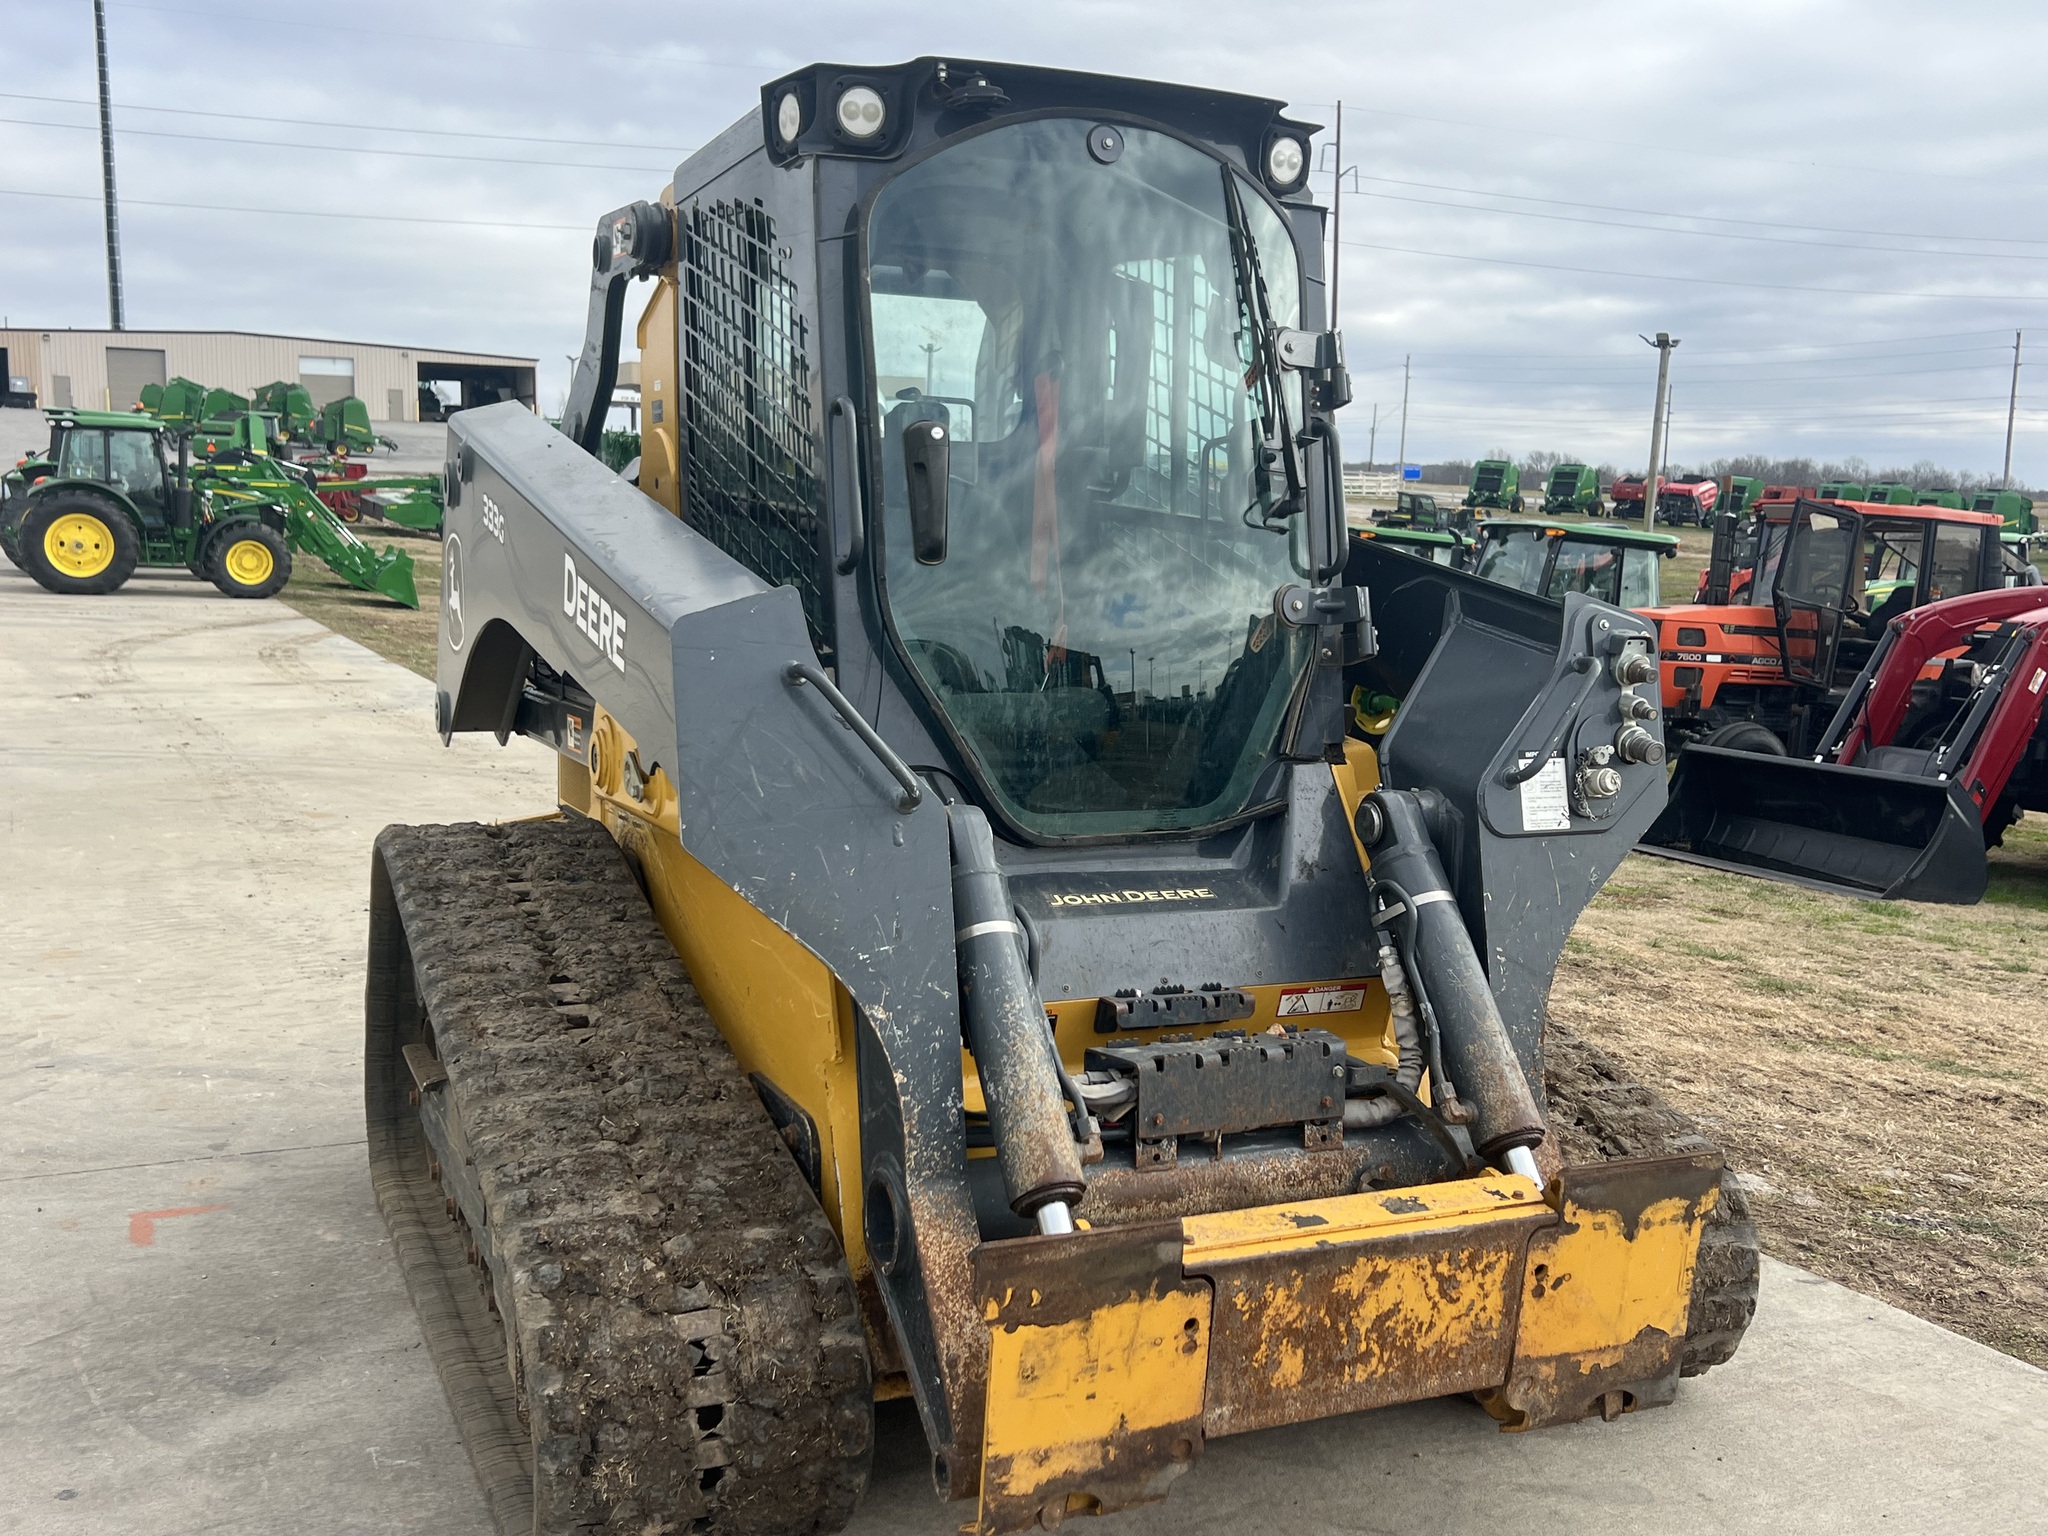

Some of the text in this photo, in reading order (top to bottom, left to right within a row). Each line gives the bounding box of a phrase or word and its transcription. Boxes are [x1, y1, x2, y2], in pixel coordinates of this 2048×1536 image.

[483, 493, 505, 545] 333G
[563, 552, 627, 673] DEERE
[1751, 656, 1777, 665] AGCO
[1050, 887, 1215, 907] JOHN DEERE
[1315, 985, 1342, 993] DANGER
